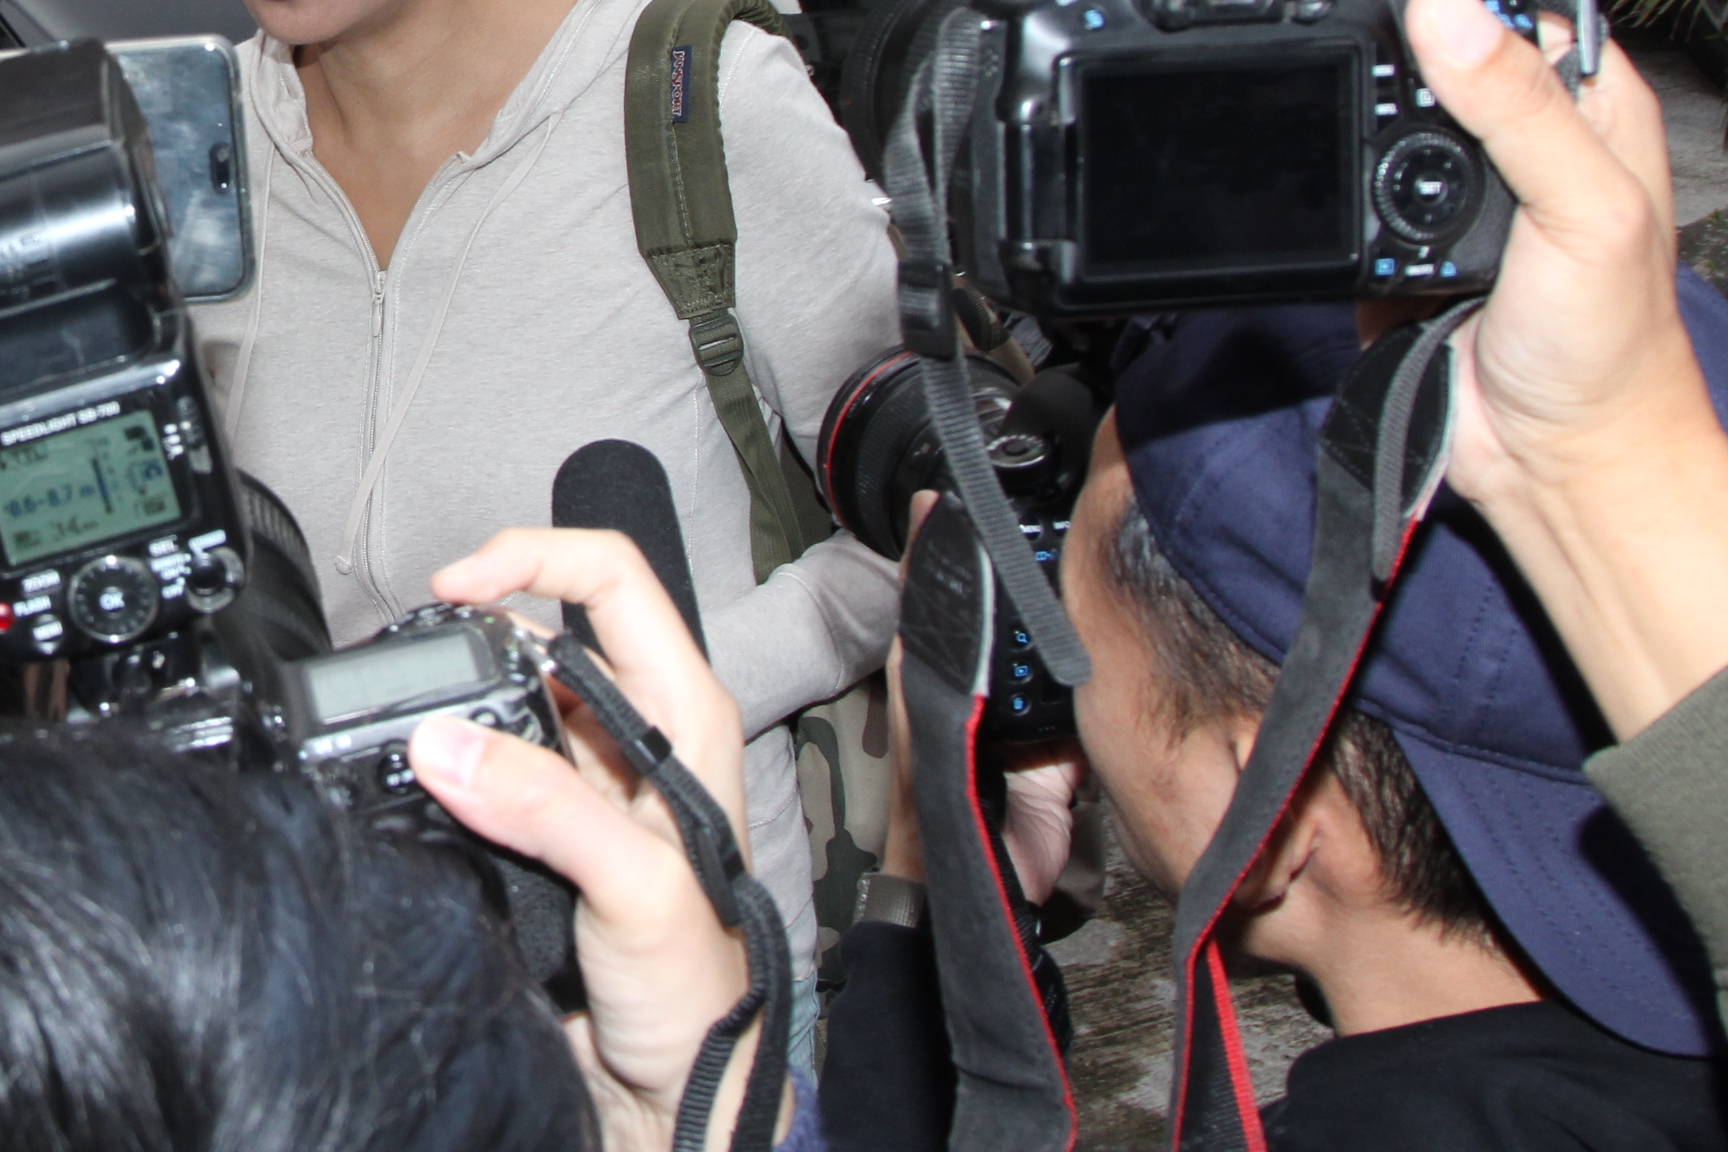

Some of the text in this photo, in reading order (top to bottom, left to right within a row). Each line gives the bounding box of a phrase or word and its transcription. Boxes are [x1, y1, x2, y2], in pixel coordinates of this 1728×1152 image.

[671, 50, 685, 117] JANSPORT
[0, 413, 77, 447] SPEEDLIGHT
[13, 595, 52, 618] FLASH
[100, 593, 126, 611] OK
